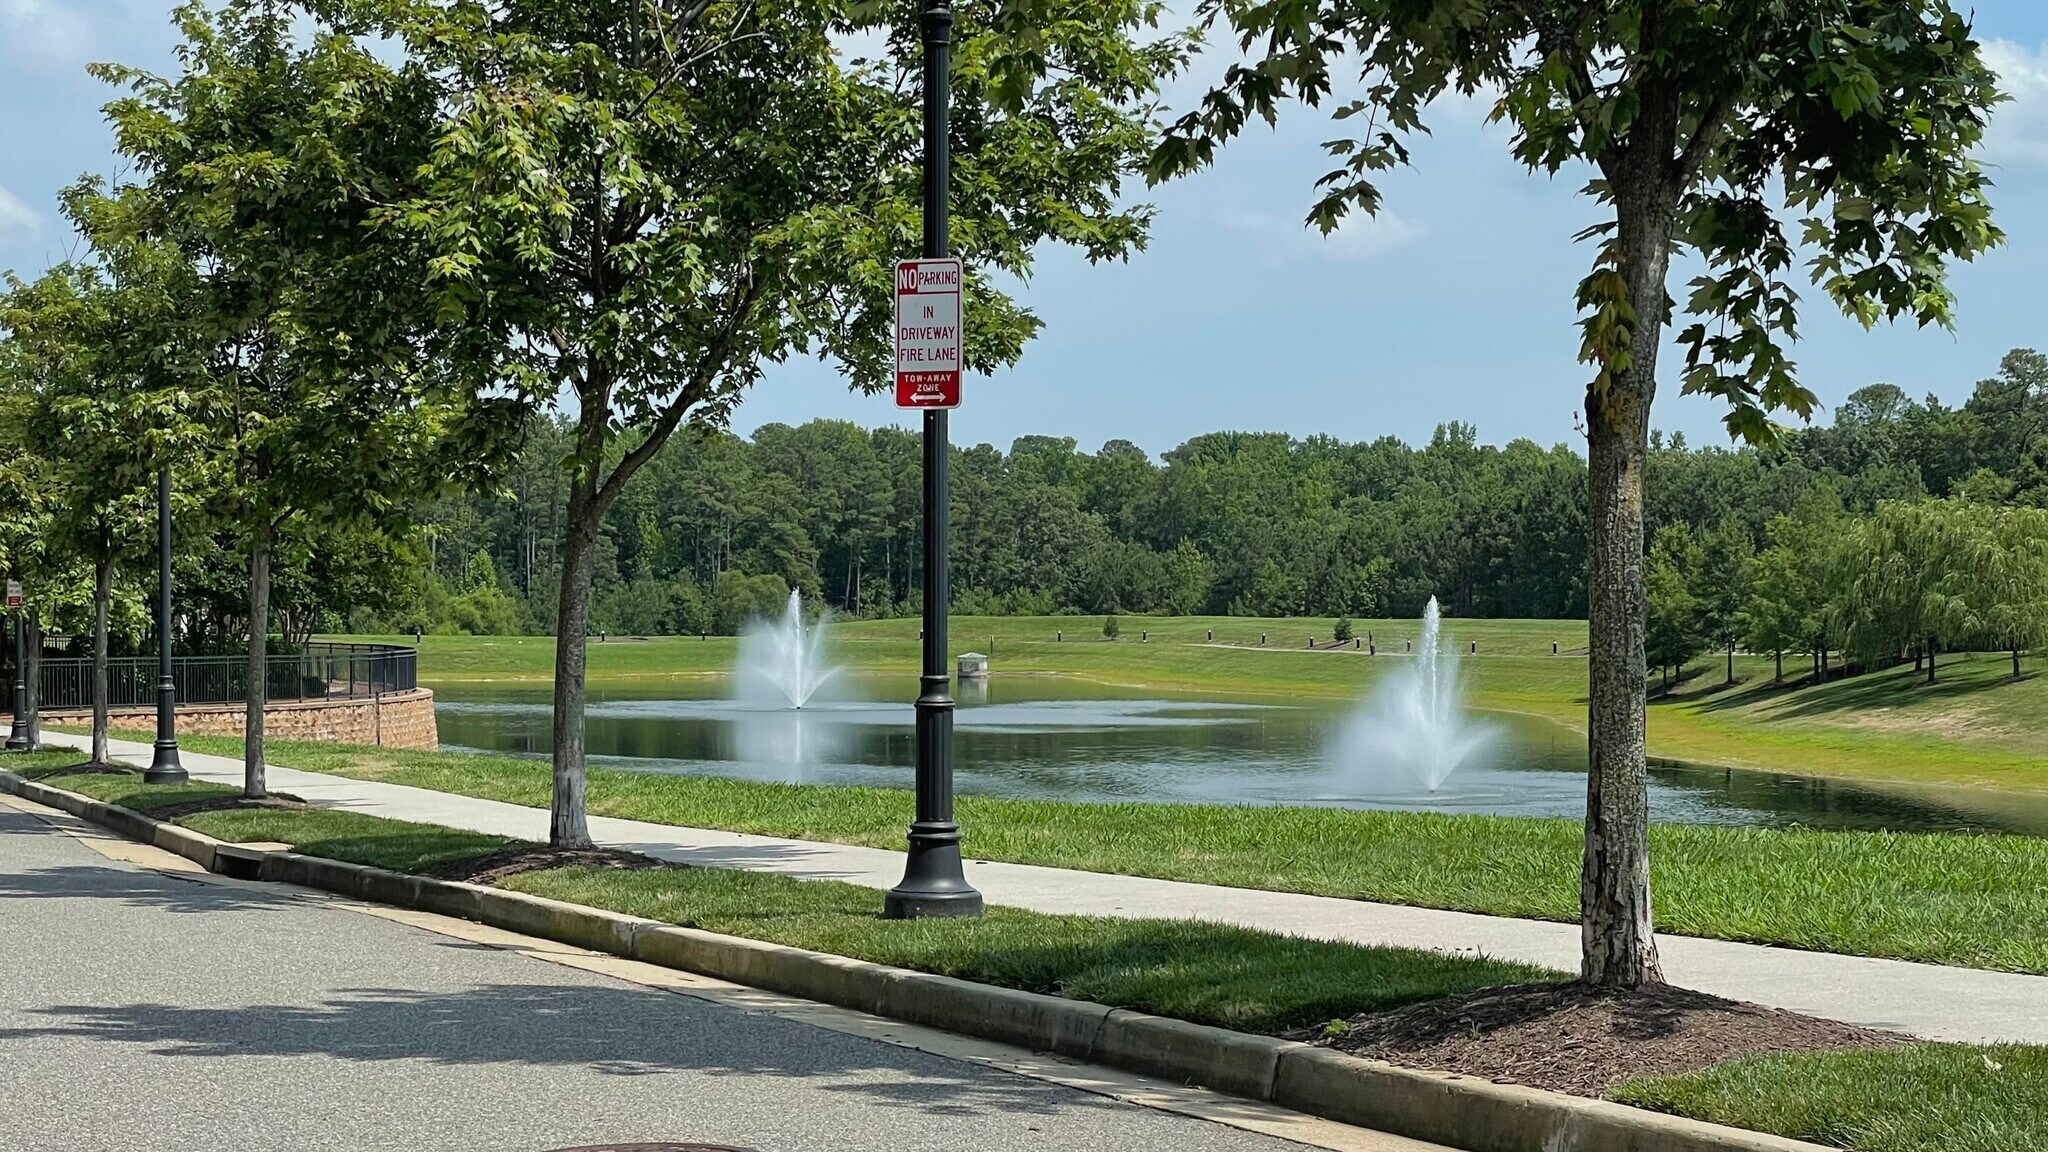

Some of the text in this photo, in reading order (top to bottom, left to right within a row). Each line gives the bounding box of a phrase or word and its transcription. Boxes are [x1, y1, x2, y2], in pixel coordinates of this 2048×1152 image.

[899, 268, 957, 290] NO PARKING
[923, 305, 934, 319] IN
[901, 326, 955, 340] DRIVEWAY
[900, 347, 956, 361] FIRE LANE
[904, 374, 952, 382] TOW-AWAY
[917, 384, 940, 392] ZONE
